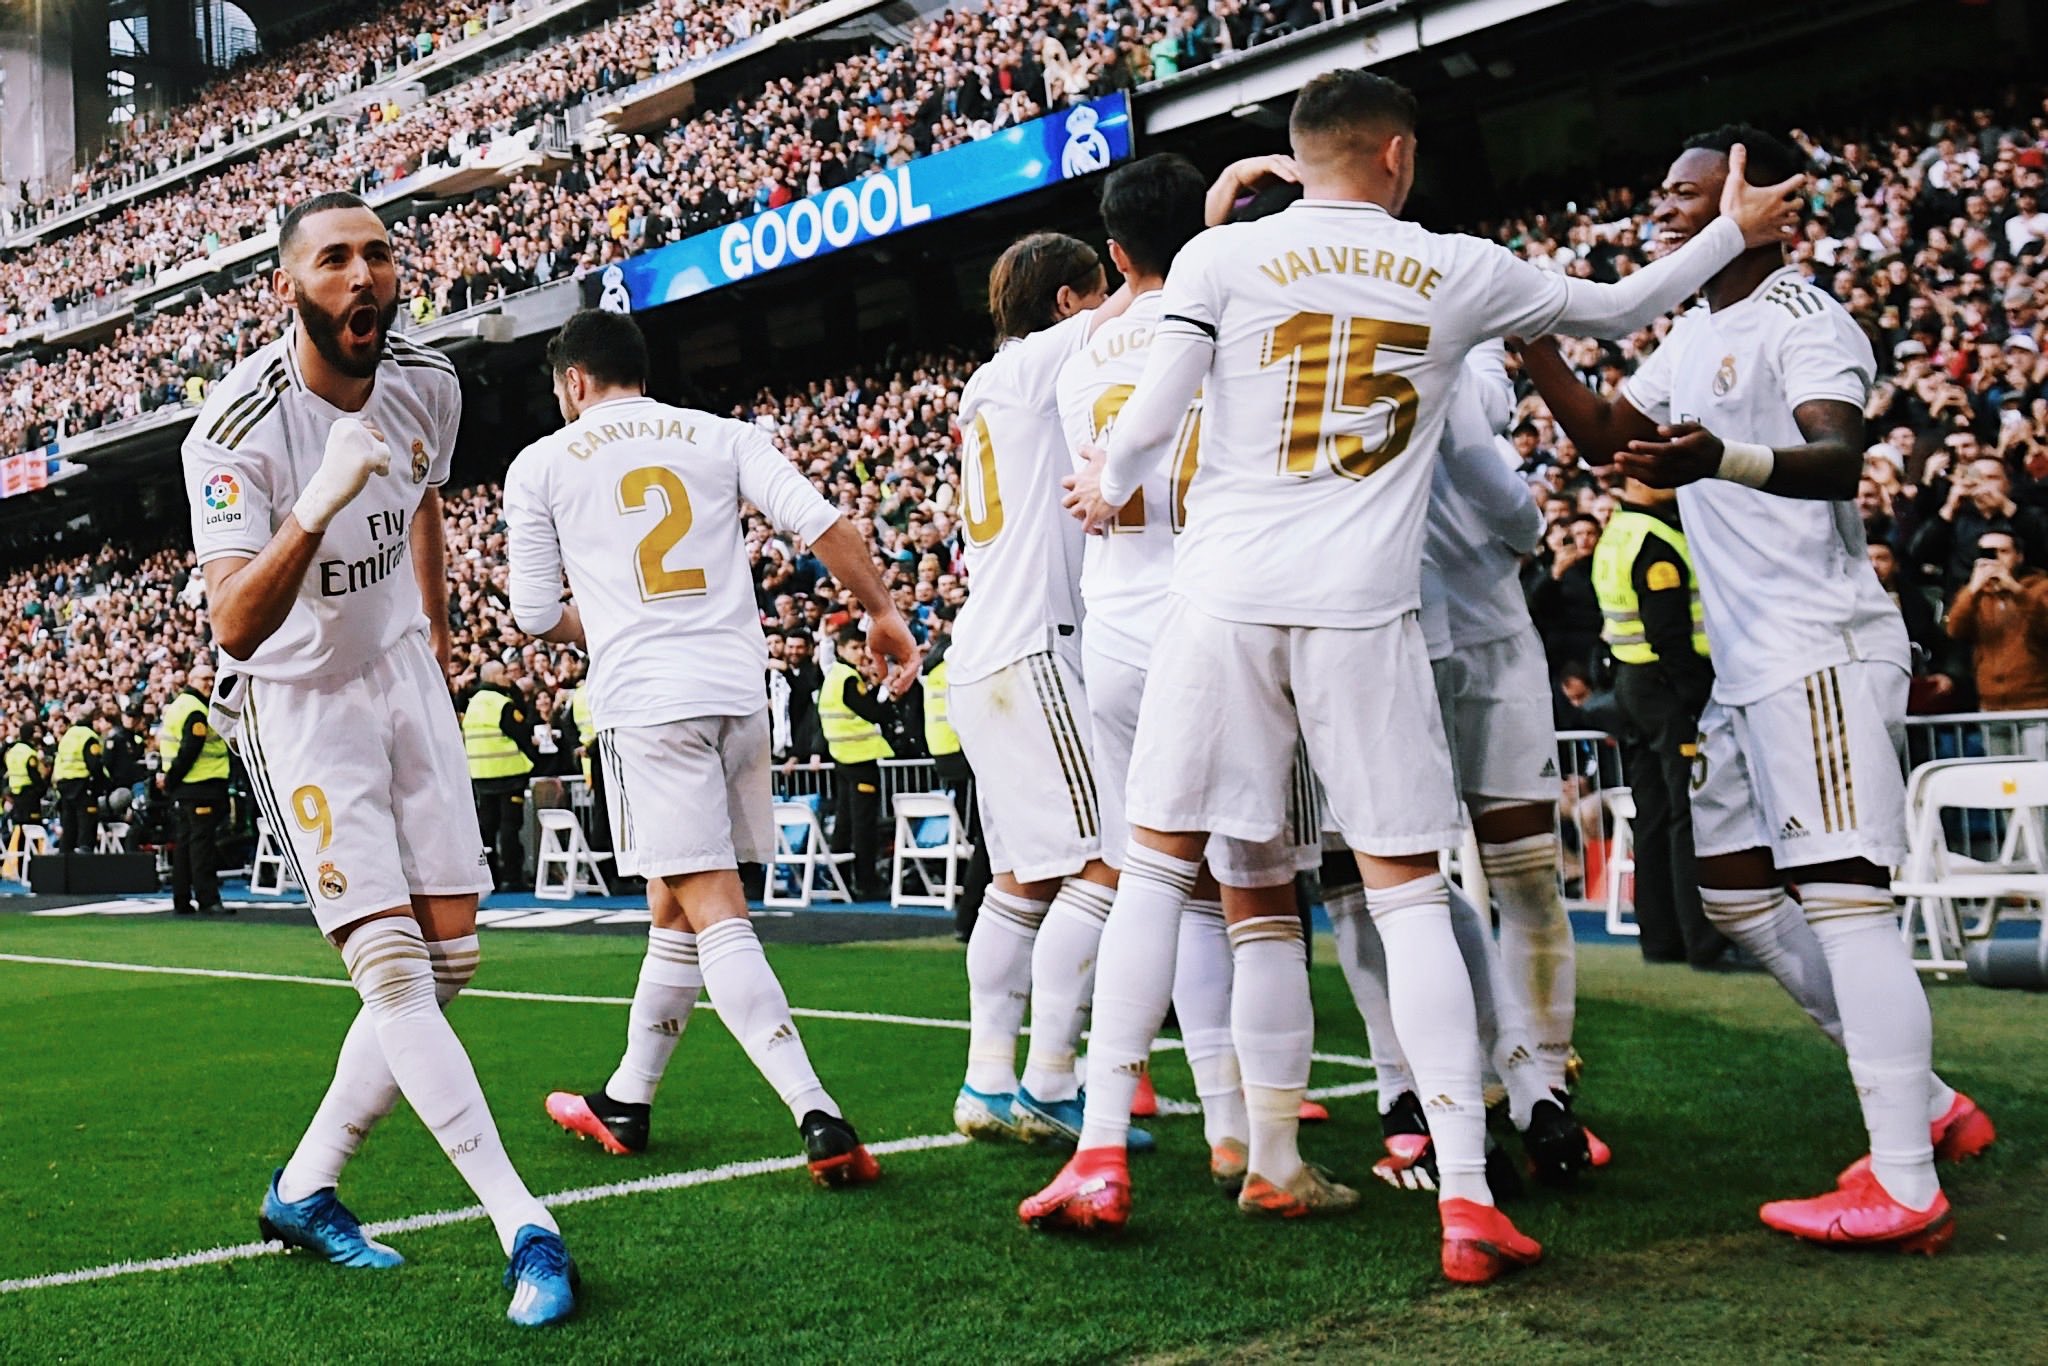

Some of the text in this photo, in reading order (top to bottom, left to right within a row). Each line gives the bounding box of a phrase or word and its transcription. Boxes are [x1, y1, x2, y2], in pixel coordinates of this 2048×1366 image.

[719, 166, 931, 280] GOOOOL
[1258, 246, 1443, 301] VALVERDE
[1260, 311, 1431, 482] 15
[567, 419, 697, 461] CARVAJAL
[206, 511, 242, 524] LaLiga
[366, 508, 404, 541] Fly
[615, 466, 707, 603] 2
[319, 540, 405, 597] Emira
[291, 785, 333, 855] 9
